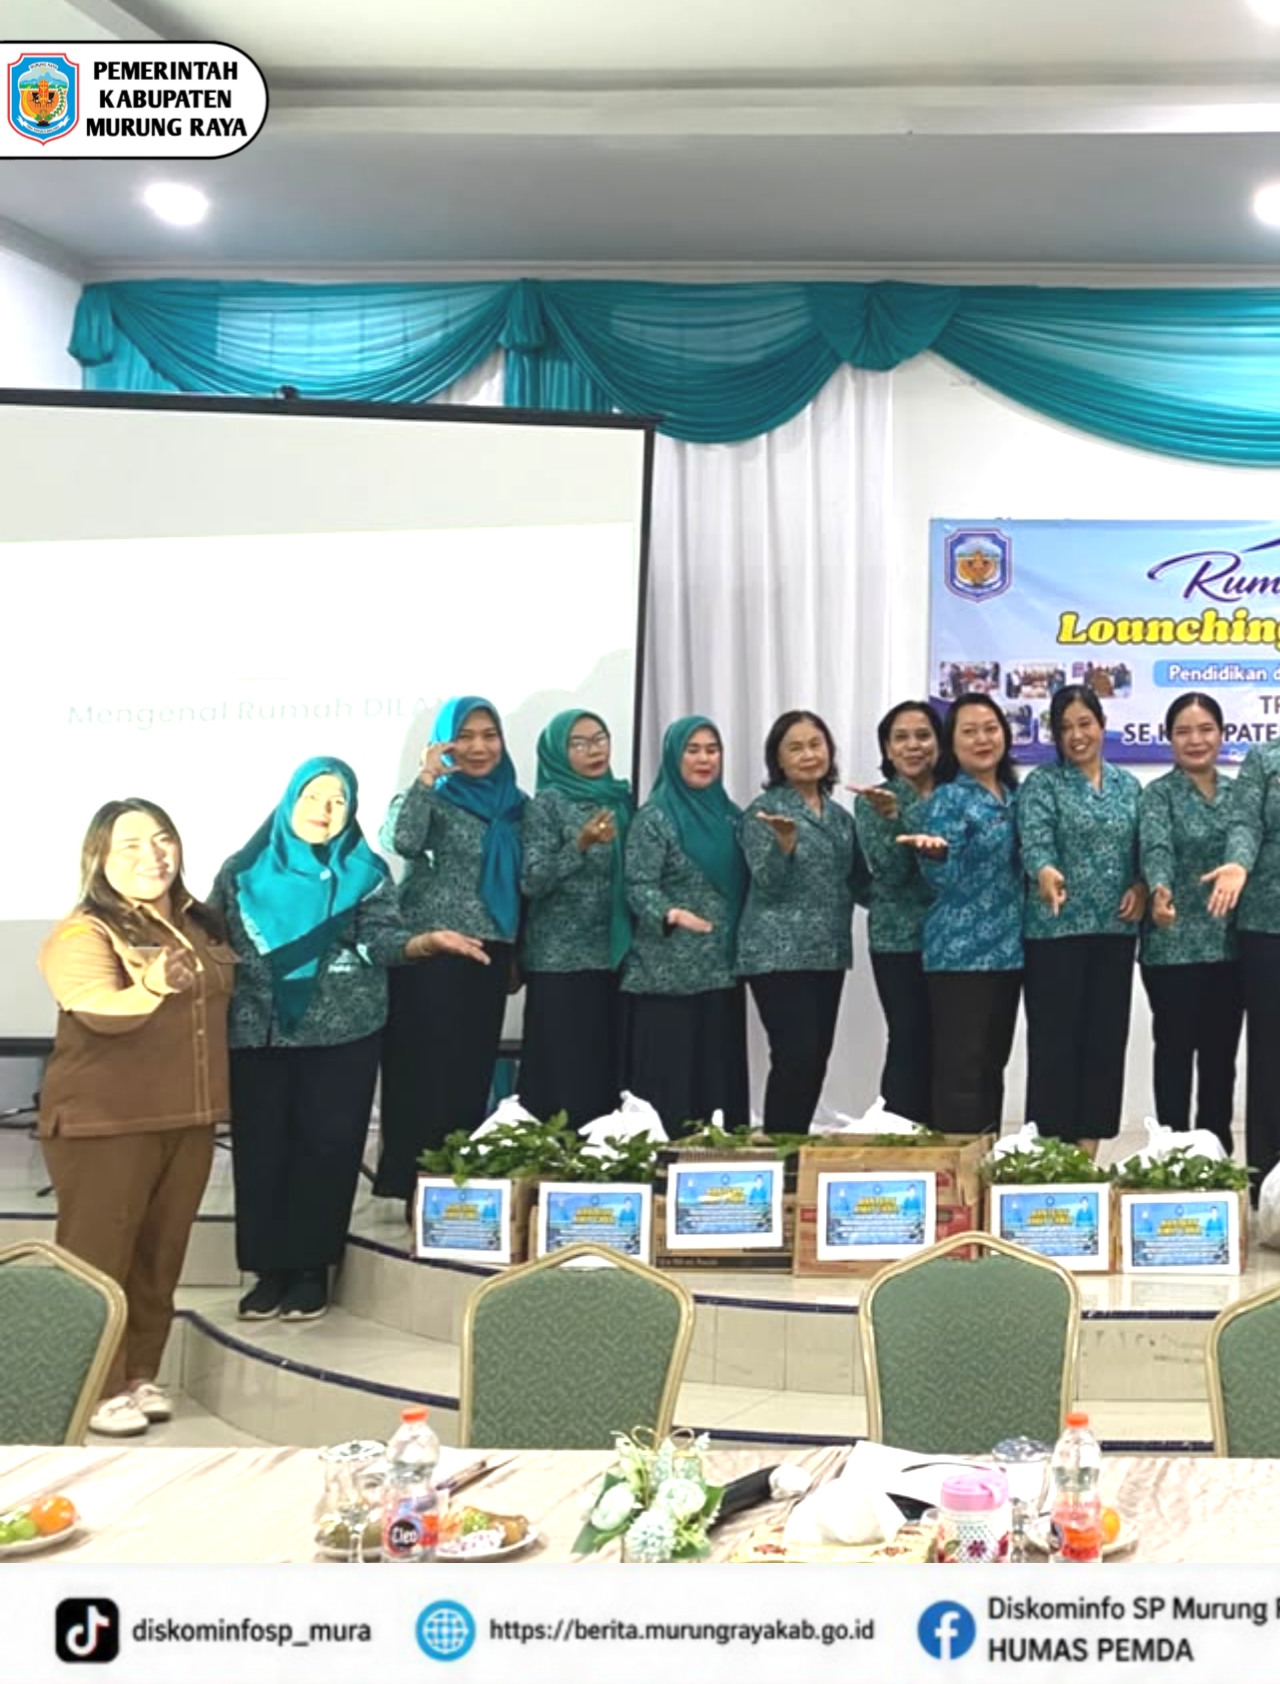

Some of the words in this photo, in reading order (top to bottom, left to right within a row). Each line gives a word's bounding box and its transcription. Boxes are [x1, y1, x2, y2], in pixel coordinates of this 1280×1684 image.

[1168, 665, 1268, 682] Pendidikan
[67, 700, 228, 731] Mengenal
[236, 696, 352, 721] Rumah
[1123, 722, 1150, 743] SE
[391, 1524, 420, 1544] Cleo
